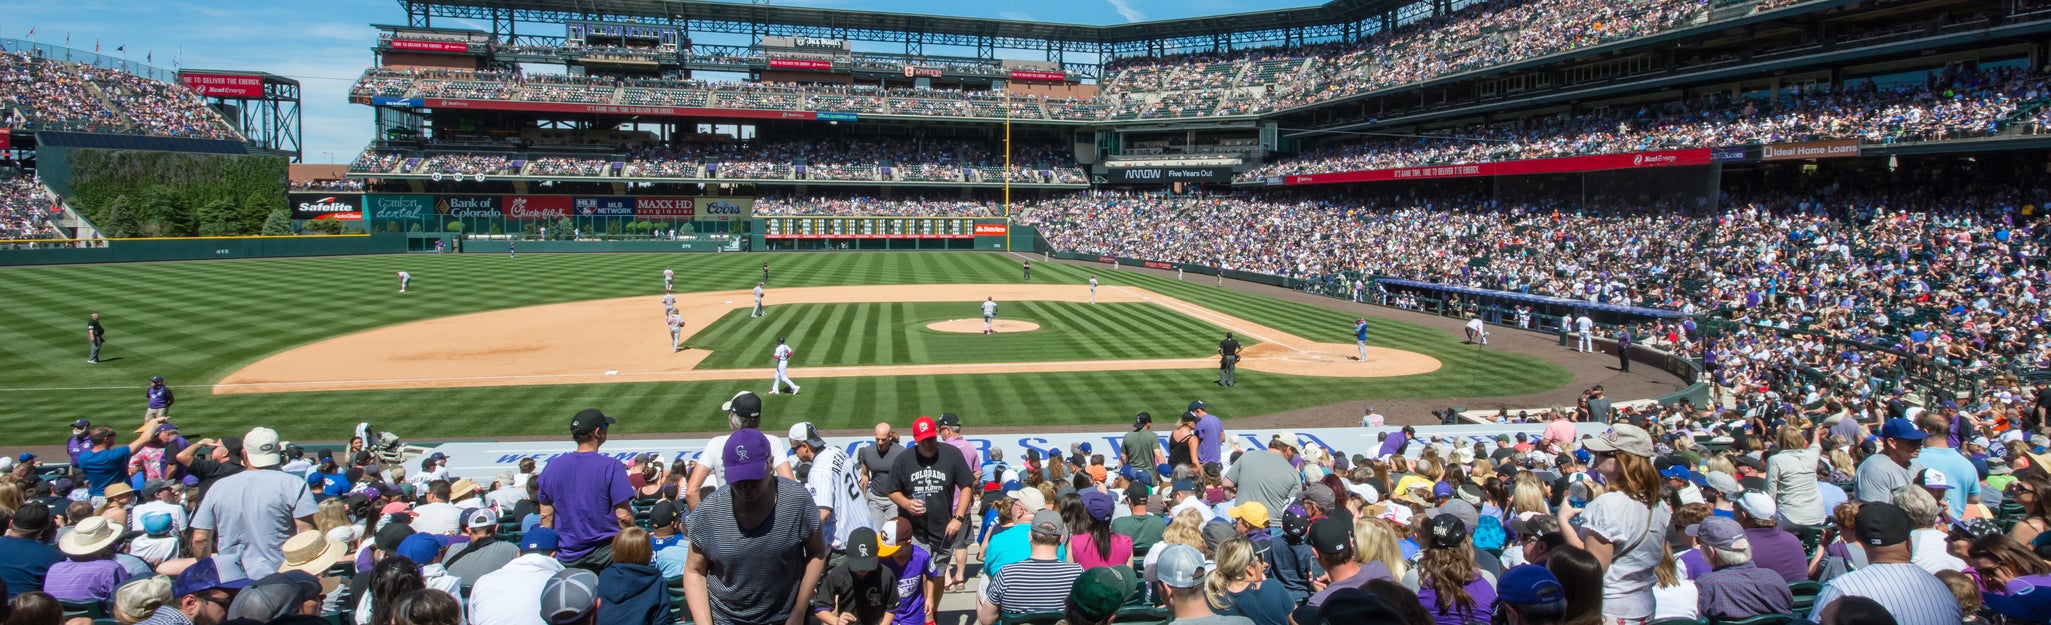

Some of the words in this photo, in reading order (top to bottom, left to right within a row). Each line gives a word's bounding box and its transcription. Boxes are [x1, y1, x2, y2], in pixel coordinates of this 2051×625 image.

[566, 23, 594, 36] THE
[606, 26, 674, 40] ROOFTOP
[1774, 148, 1795, 156] Ideal
[1798, 147, 1825, 155] Home
[1828, 145, 1857, 153] Loans
[1125, 170, 1160, 179] ARROW
[299, 202, 352, 211] Safelite
[378, 196, 417, 208] Comfort
[451, 198, 478, 208] Bank
[480, 198, 492, 208] of
[638, 200, 673, 208] MAXX
[676, 200, 692, 208] HD
[376, 205, 422, 218] dental
[451, 208, 500, 217] Colorado
[706, 202, 740, 214] Coors
[911, 470, 946, 481] COLORADO
